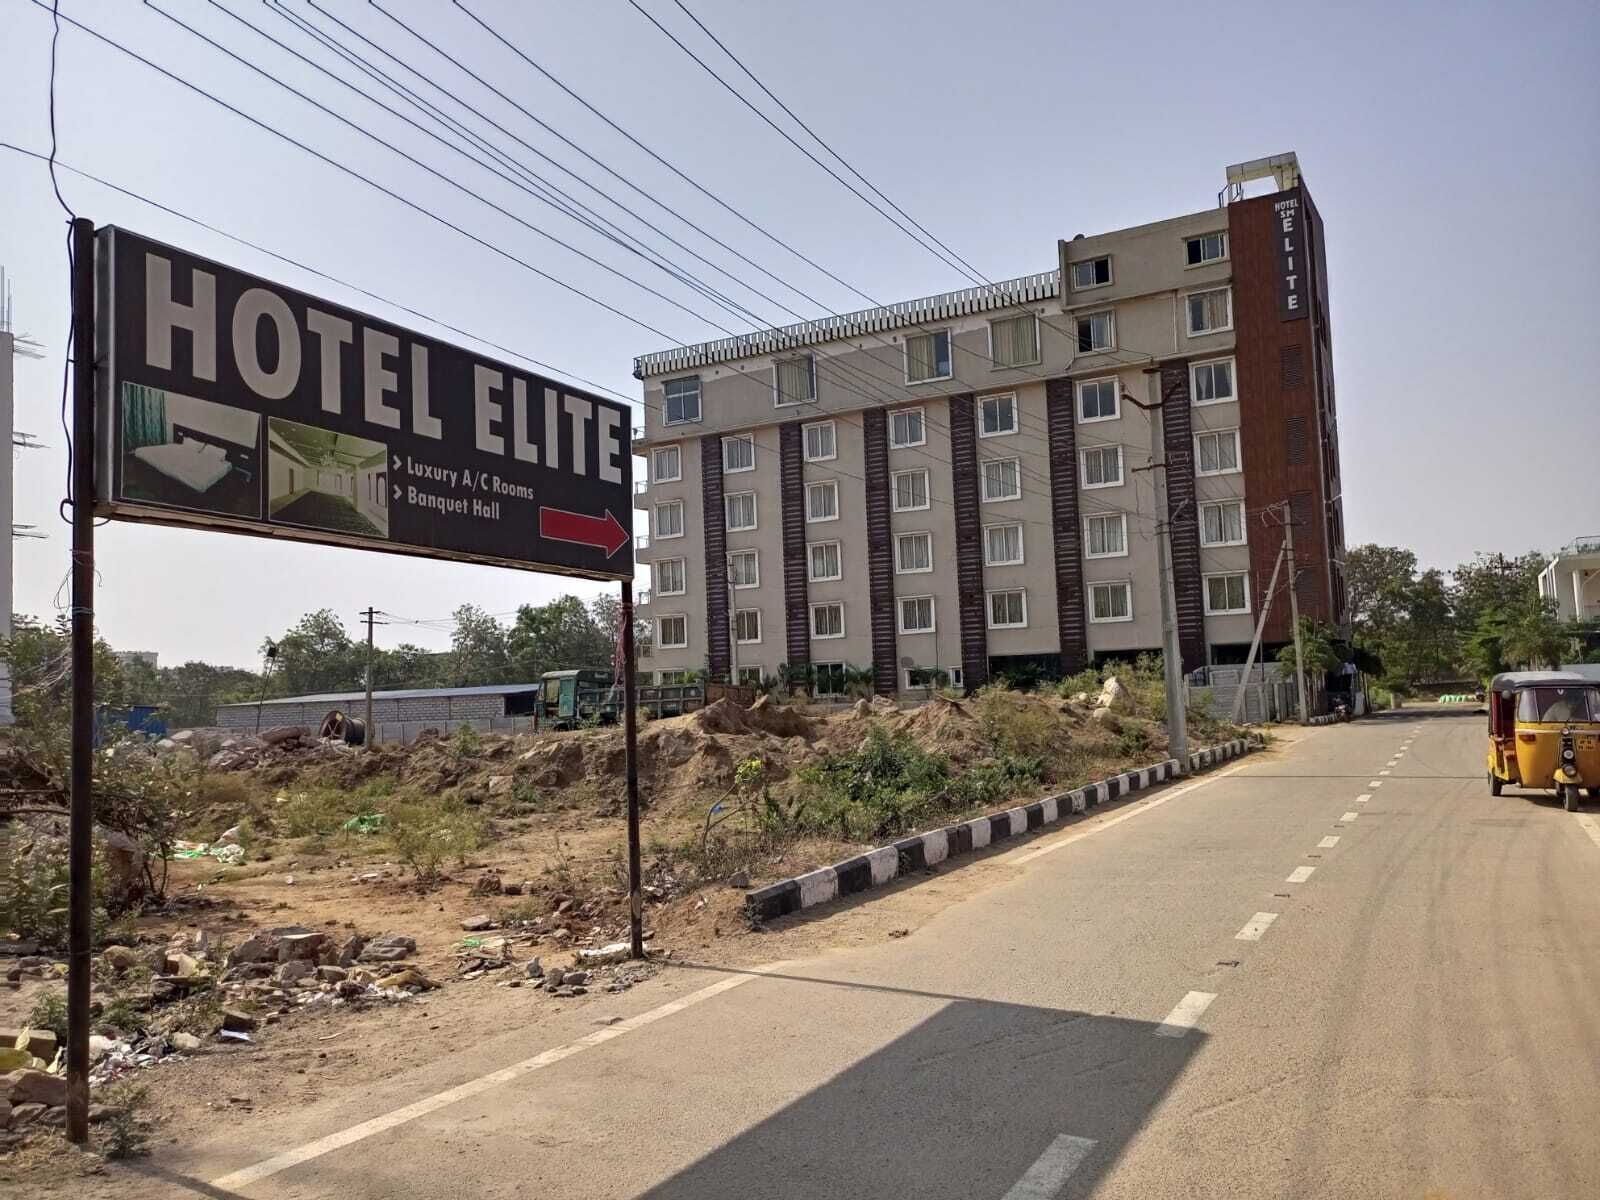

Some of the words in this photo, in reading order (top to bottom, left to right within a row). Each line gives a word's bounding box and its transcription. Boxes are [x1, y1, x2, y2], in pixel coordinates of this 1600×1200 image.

[1275, 199, 1298, 213] HOTEL
[1282, 218, 1298, 310] ELITE
[145, 252, 442, 440] HOTEL
[474, 363, 622, 484] ELITE
[407, 456, 458, 487] Luxury
[462, 469, 489, 491] A/C
[492, 478, 534, 500] Rooms
[407, 485, 469, 514] Banquet
[472, 500, 500, 520] Hall
